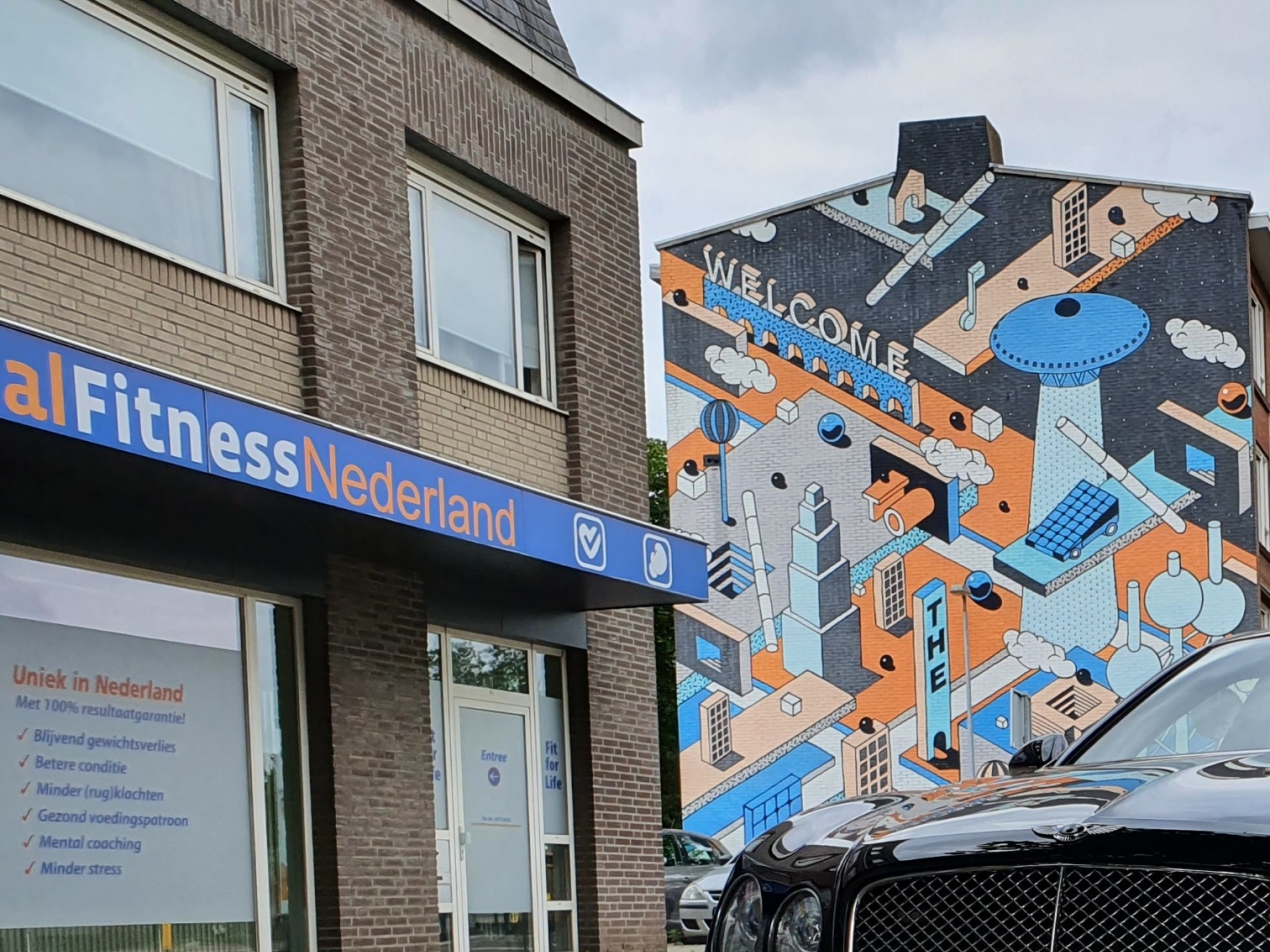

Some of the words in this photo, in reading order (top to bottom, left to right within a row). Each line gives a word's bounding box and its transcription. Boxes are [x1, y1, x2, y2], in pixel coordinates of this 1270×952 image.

[702, 244, 911, 382] WELCOME
[926, 597, 947, 694] THE
[13, 664, 67, 690] Uniek
[73, 670, 89, 692] in
[95, 674, 184, 702] Nederland
[15, 695, 41, 710] Met
[45, 698, 79, 714] 100%
[82, 703, 186, 724] resultaatgarantie!
[34, 728, 85, 746] Blijvend
[87, 735, 176, 753] gewichtsverlies
[545, 740, 558, 755] Fit
[35, 755, 76, 771] Betere
[78, 760, 127, 774] conditie
[481, 750, 507, 762] Entree
[545, 757, 559, 771] for
[36, 782, 82, 797] Minder
[545, 775, 562, 790] Life
[38, 808, 87, 823] Gezond
[89, 811, 189, 829] voedingspatroon
[39, 835, 85, 849] Mental
[87, 836, 142, 853] coaching
[40, 861, 86, 875] Minder
[87, 863, 122, 875] stress
